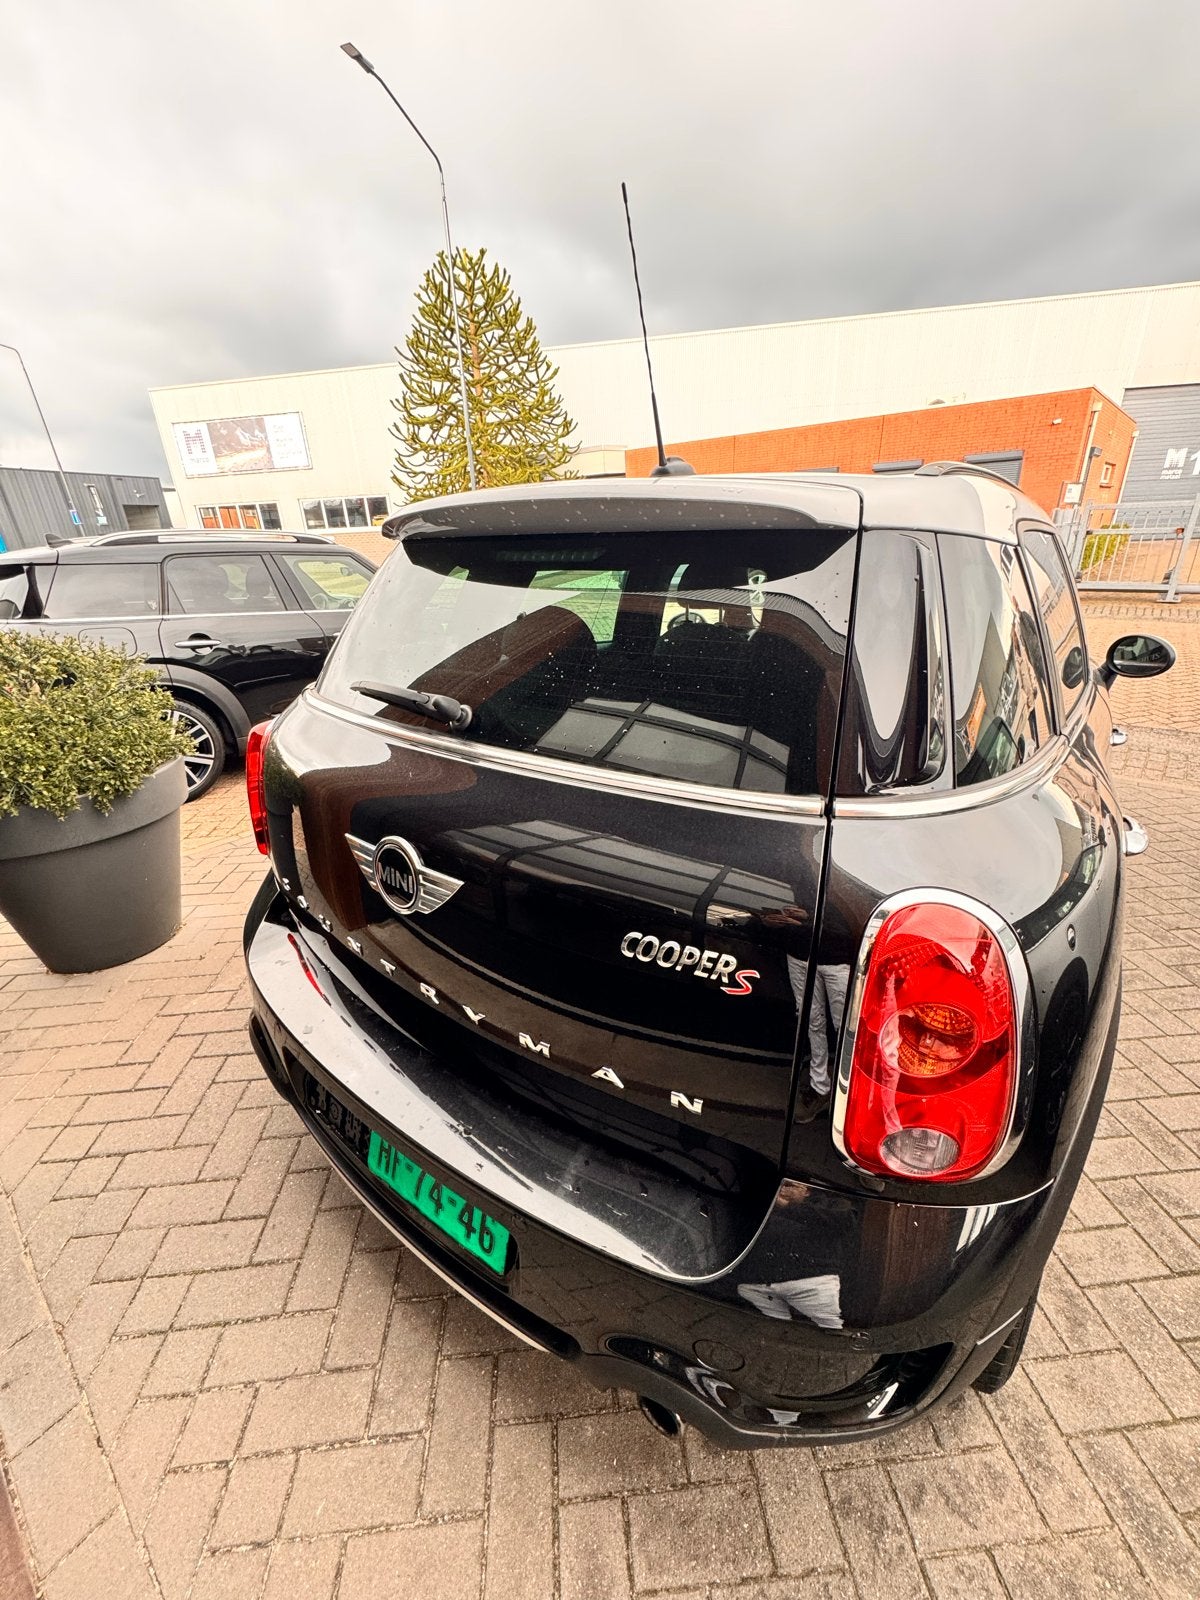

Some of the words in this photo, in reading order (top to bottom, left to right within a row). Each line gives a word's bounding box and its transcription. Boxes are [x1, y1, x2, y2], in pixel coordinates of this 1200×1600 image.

[376, 862, 414, 894] MINI
[282, 877, 704, 1114] COUNTRYMAN
[620, 931, 738, 984] COOPER
[720, 969, 761, 996] S
